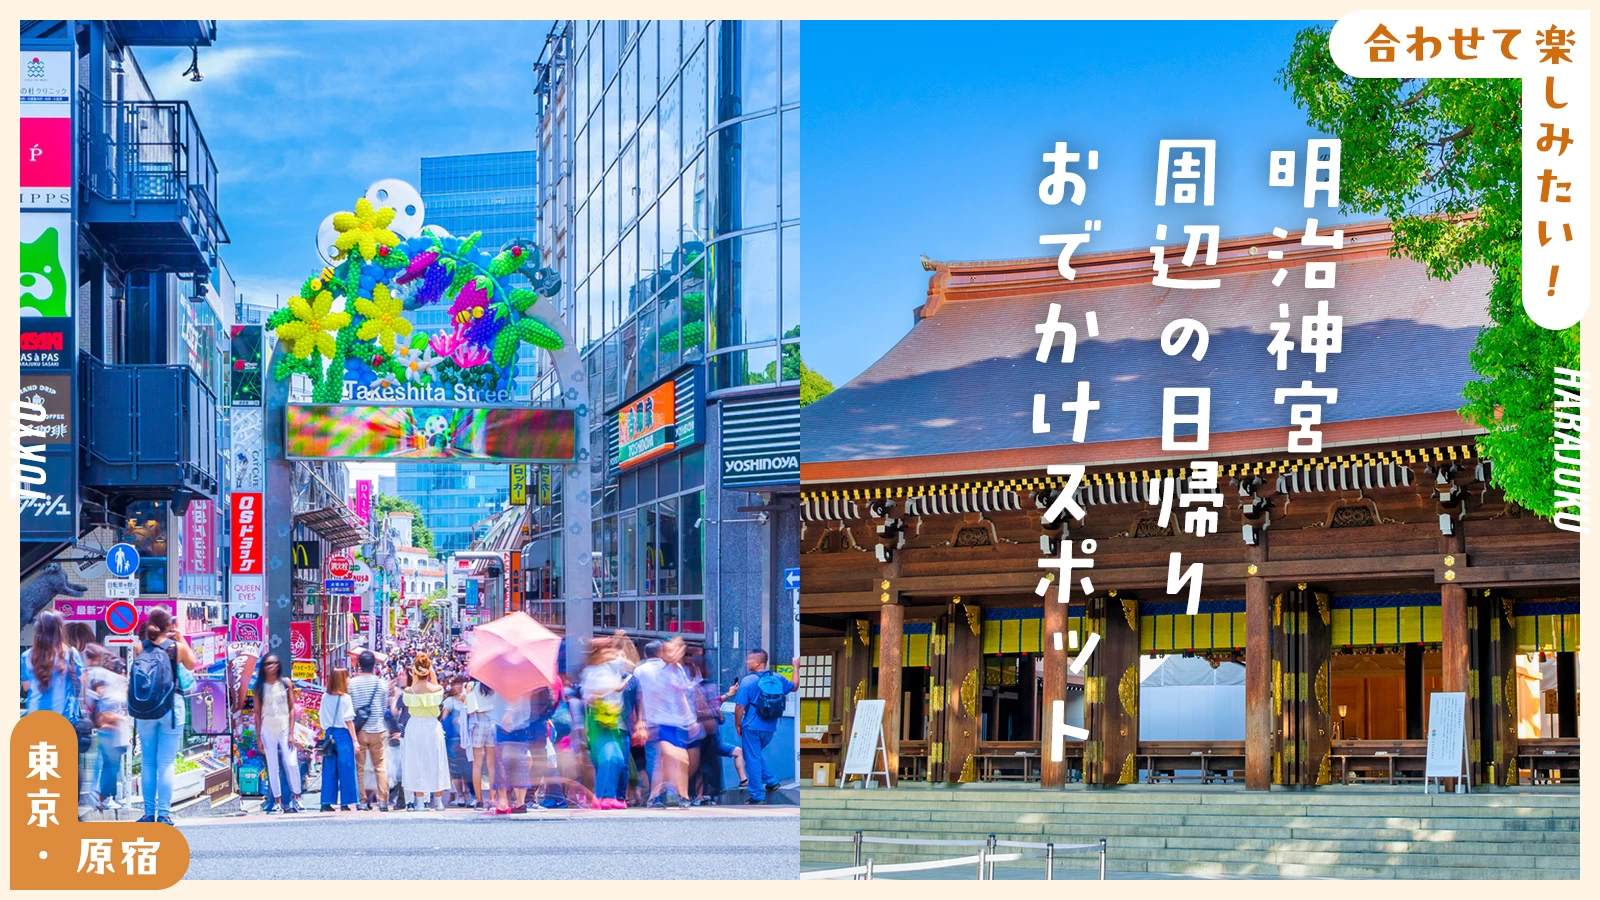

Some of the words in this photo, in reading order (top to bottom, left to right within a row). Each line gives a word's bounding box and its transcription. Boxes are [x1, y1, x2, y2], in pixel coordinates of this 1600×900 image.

[41, 353, 59, 361] PAS
[39, 385, 57, 394] DRIP
[344, 382, 446, 400] Takeshita
[454, 384, 517, 401] Street
[252, 450, 260, 465] CAT
[725, 456, 799, 473] YOSHINOYA
[252, 467, 260, 488] CAFE
[239, 496, 256, 571] OSドラッグ
[234, 584, 260, 592] QUEEN
